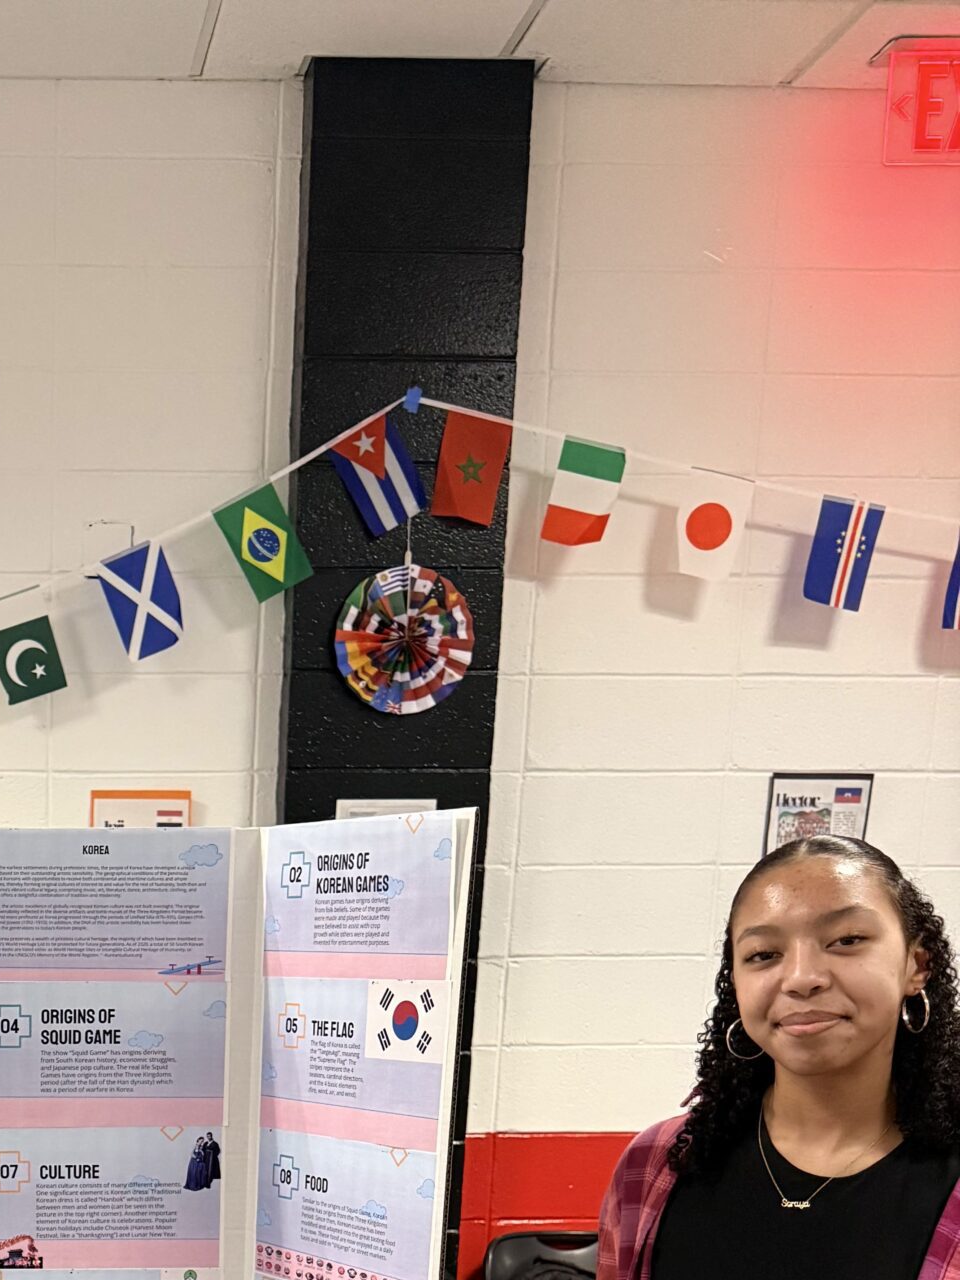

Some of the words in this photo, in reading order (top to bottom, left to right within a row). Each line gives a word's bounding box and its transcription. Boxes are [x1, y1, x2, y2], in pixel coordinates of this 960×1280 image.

[83, 845, 109, 854] KOREA
[289, 867, 302, 883] 02
[317, 853, 353, 871] ORIGINS
[356, 852, 369, 870] OF
[317, 876, 353, 894] KOREAN
[356, 875, 389, 892] GAMES
[0, 1019, 19, 1034] 04
[41, 1009, 94, 1023] ORIGINS
[98, 1009, 115, 1023] OF
[286, 1018, 297, 1033] 05
[312, 1020, 328, 1037] THE
[331, 1020, 354, 1038] FLAG
[41, 1030, 81, 1045] SQUID
[85, 1030, 121, 1044] GAME
[0, 1165, 18, 1178] 07
[40, 1165, 100, 1179] CULTURE
[280, 1168, 292, 1185] 08
[305, 1174, 328, 1192] FOOD
